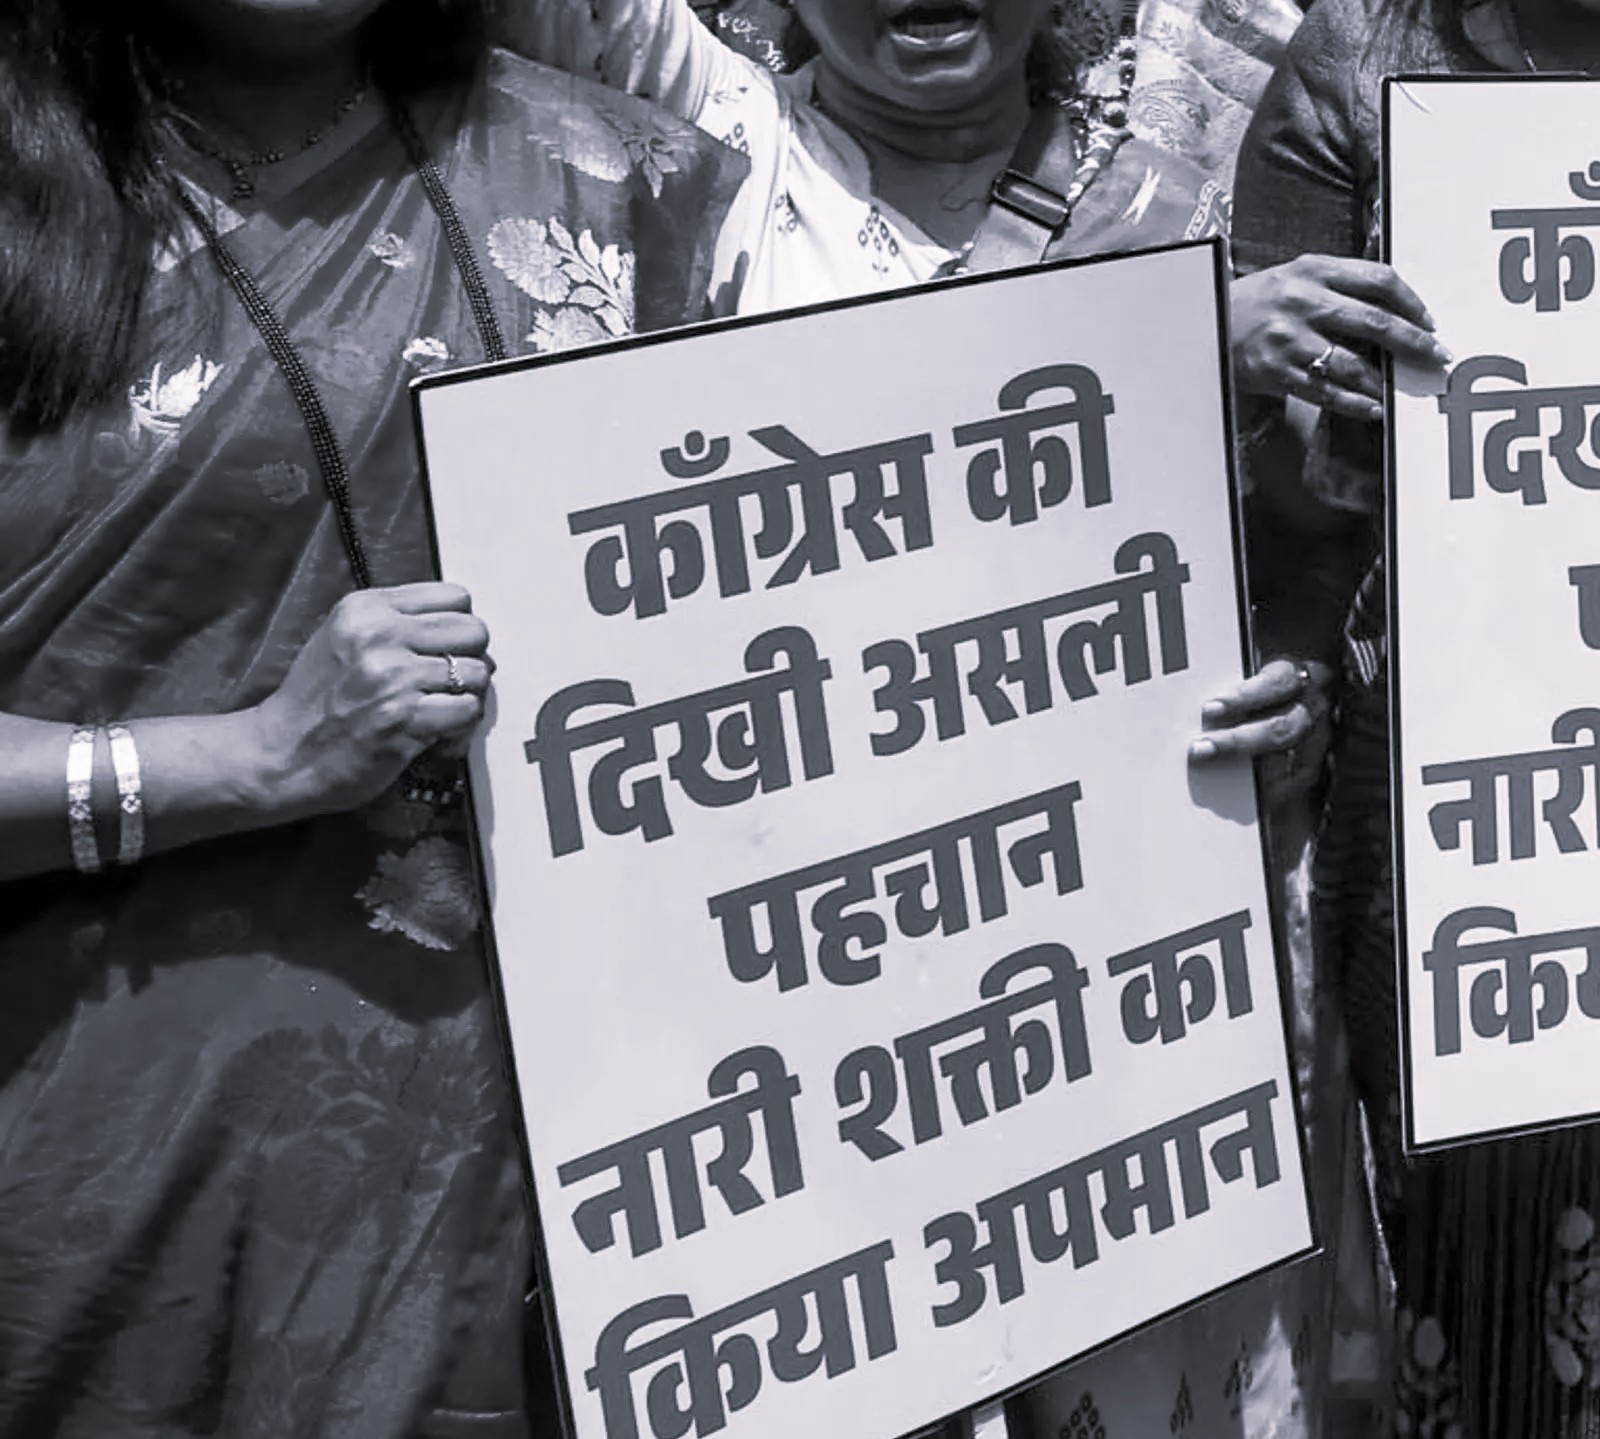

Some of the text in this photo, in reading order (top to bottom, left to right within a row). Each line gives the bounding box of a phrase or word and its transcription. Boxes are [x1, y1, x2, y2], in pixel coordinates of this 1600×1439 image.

[567, 363, 1116, 620] काँग्रेस की
[524, 531, 1192, 859] दिखी असली
[707, 780, 1084, 994] पहचान
[557, 907, 1254, 1259] नारी शक्ती का
[584, 1078, 1282, 1439] किया अपमान
